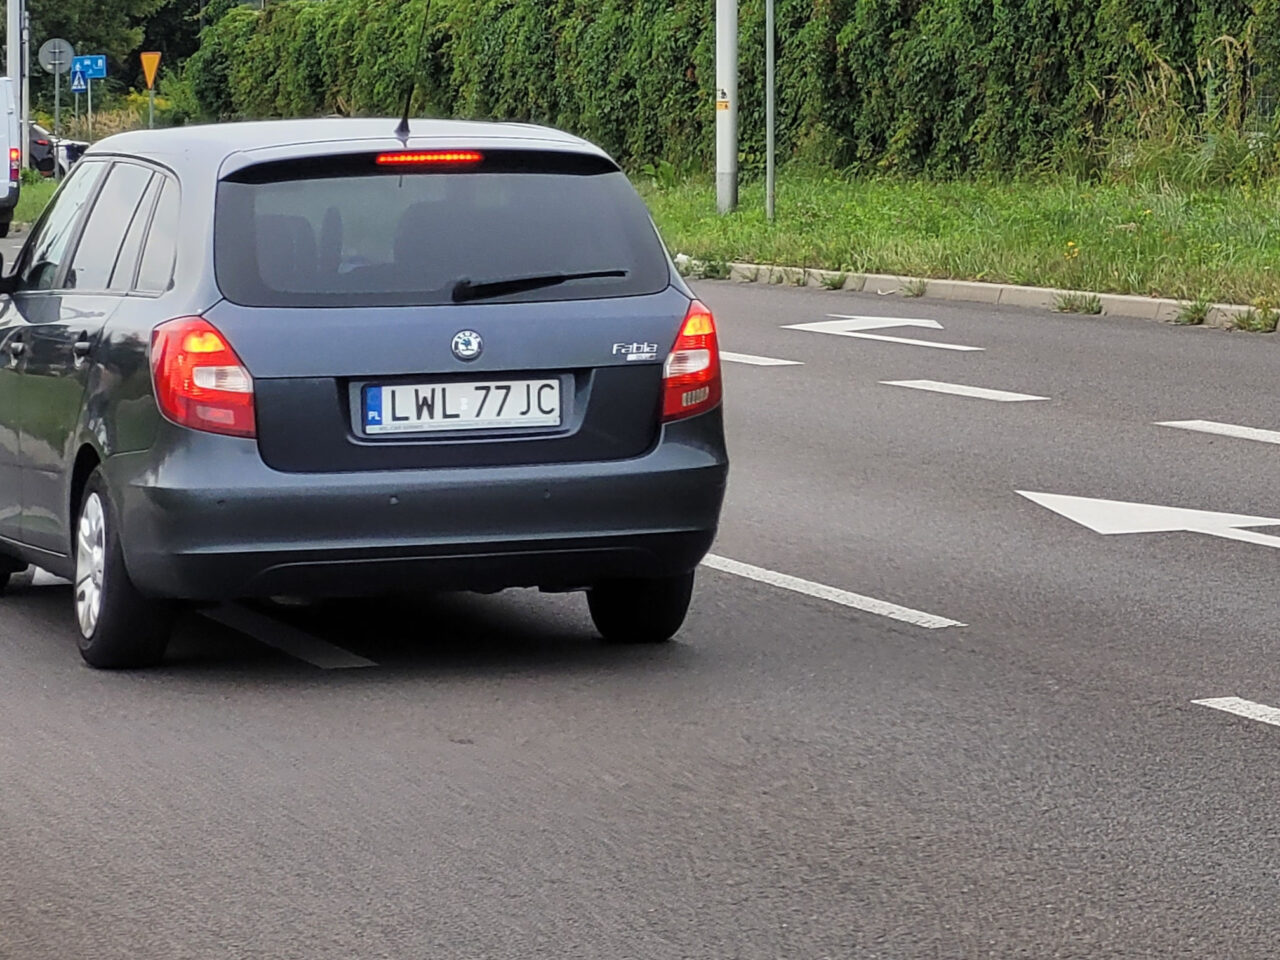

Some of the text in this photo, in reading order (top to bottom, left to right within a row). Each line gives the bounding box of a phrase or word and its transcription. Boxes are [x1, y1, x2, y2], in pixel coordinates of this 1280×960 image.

[612, 341, 658, 355] Fabia
[391, 387, 460, 421] LWL
[368, 411, 381, 420] PL
